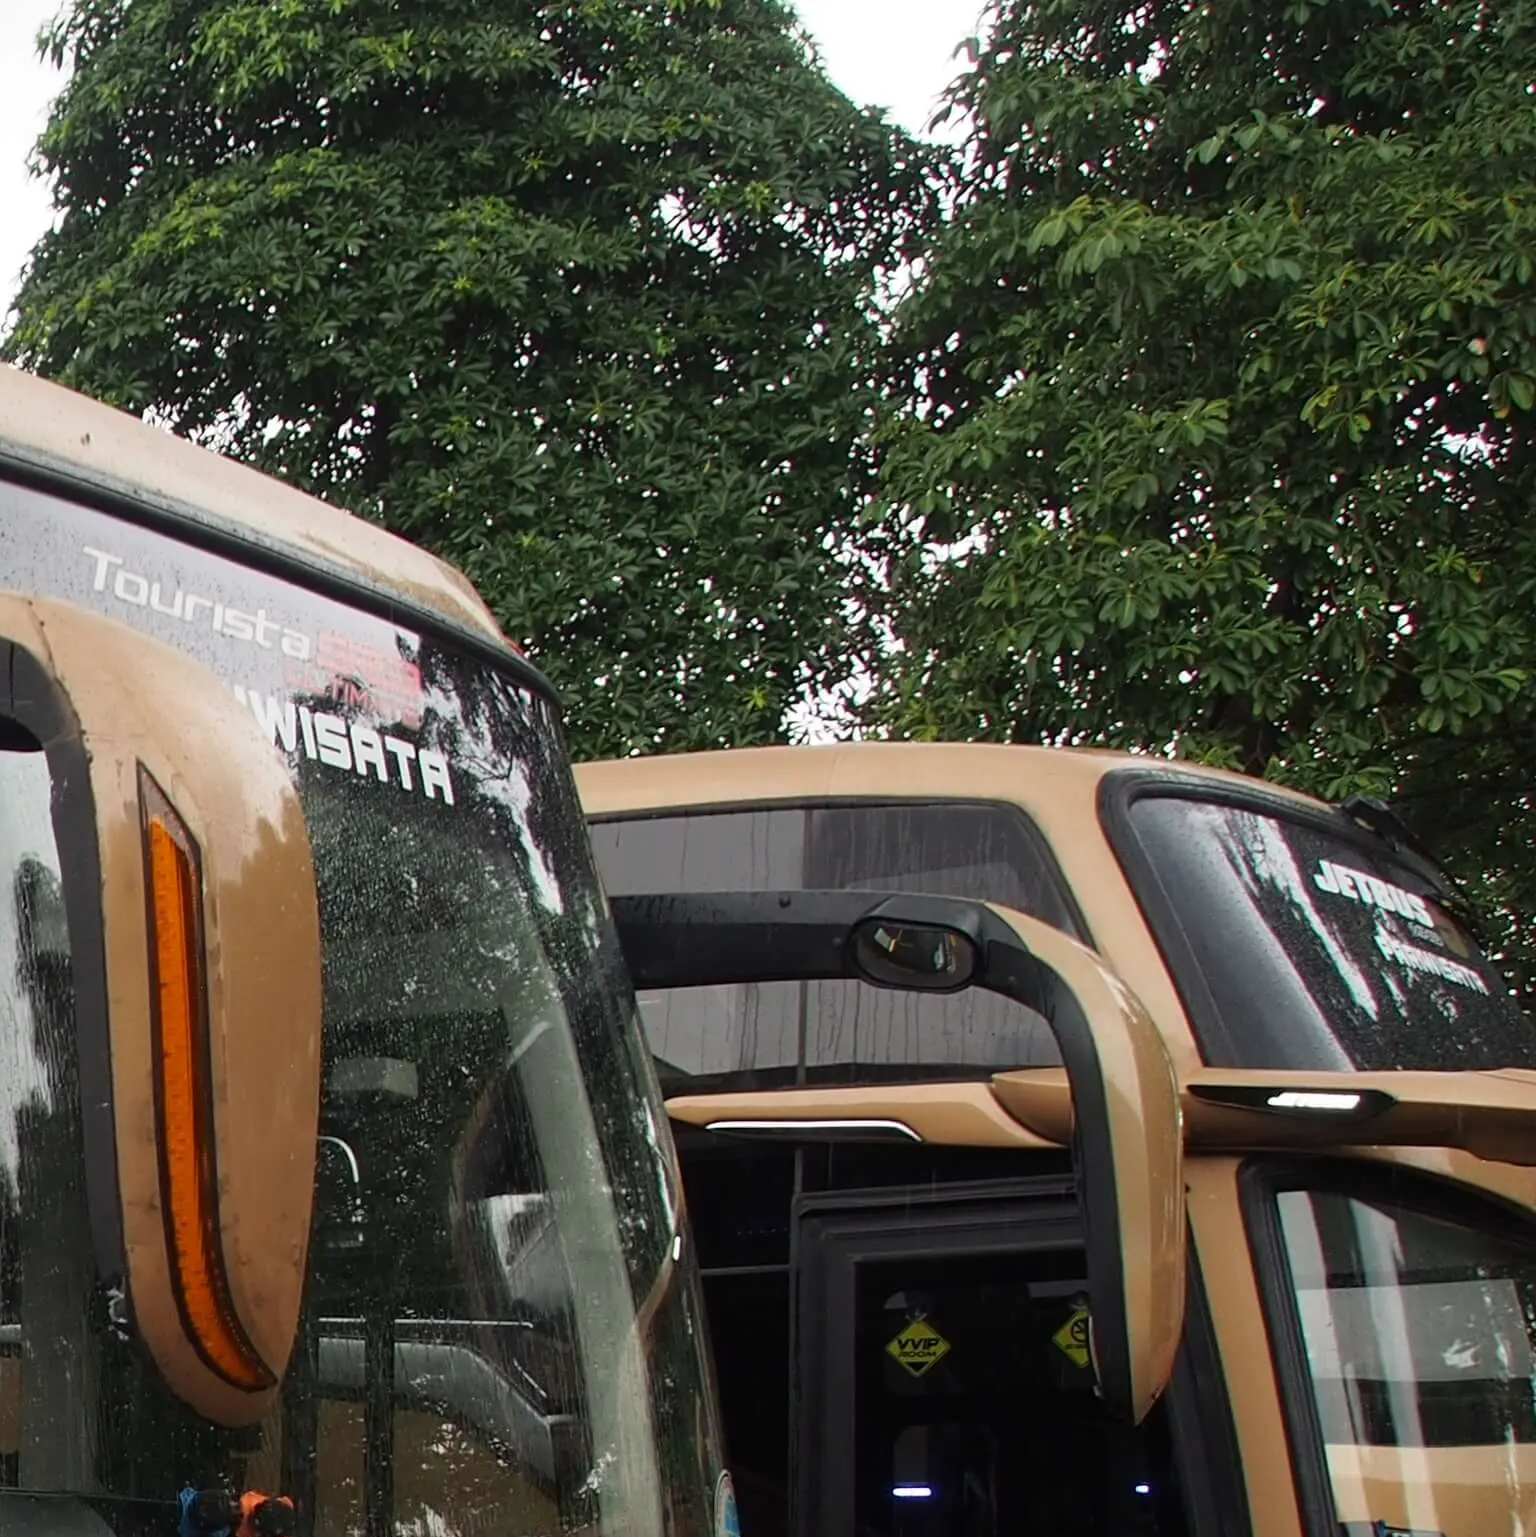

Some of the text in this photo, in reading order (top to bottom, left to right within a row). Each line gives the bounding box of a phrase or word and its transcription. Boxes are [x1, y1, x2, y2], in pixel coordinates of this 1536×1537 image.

[82, 546, 311, 662] Tourista
[1313, 859, 1435, 928] JETBUS
[897, 1337, 940, 1351] VVIP
